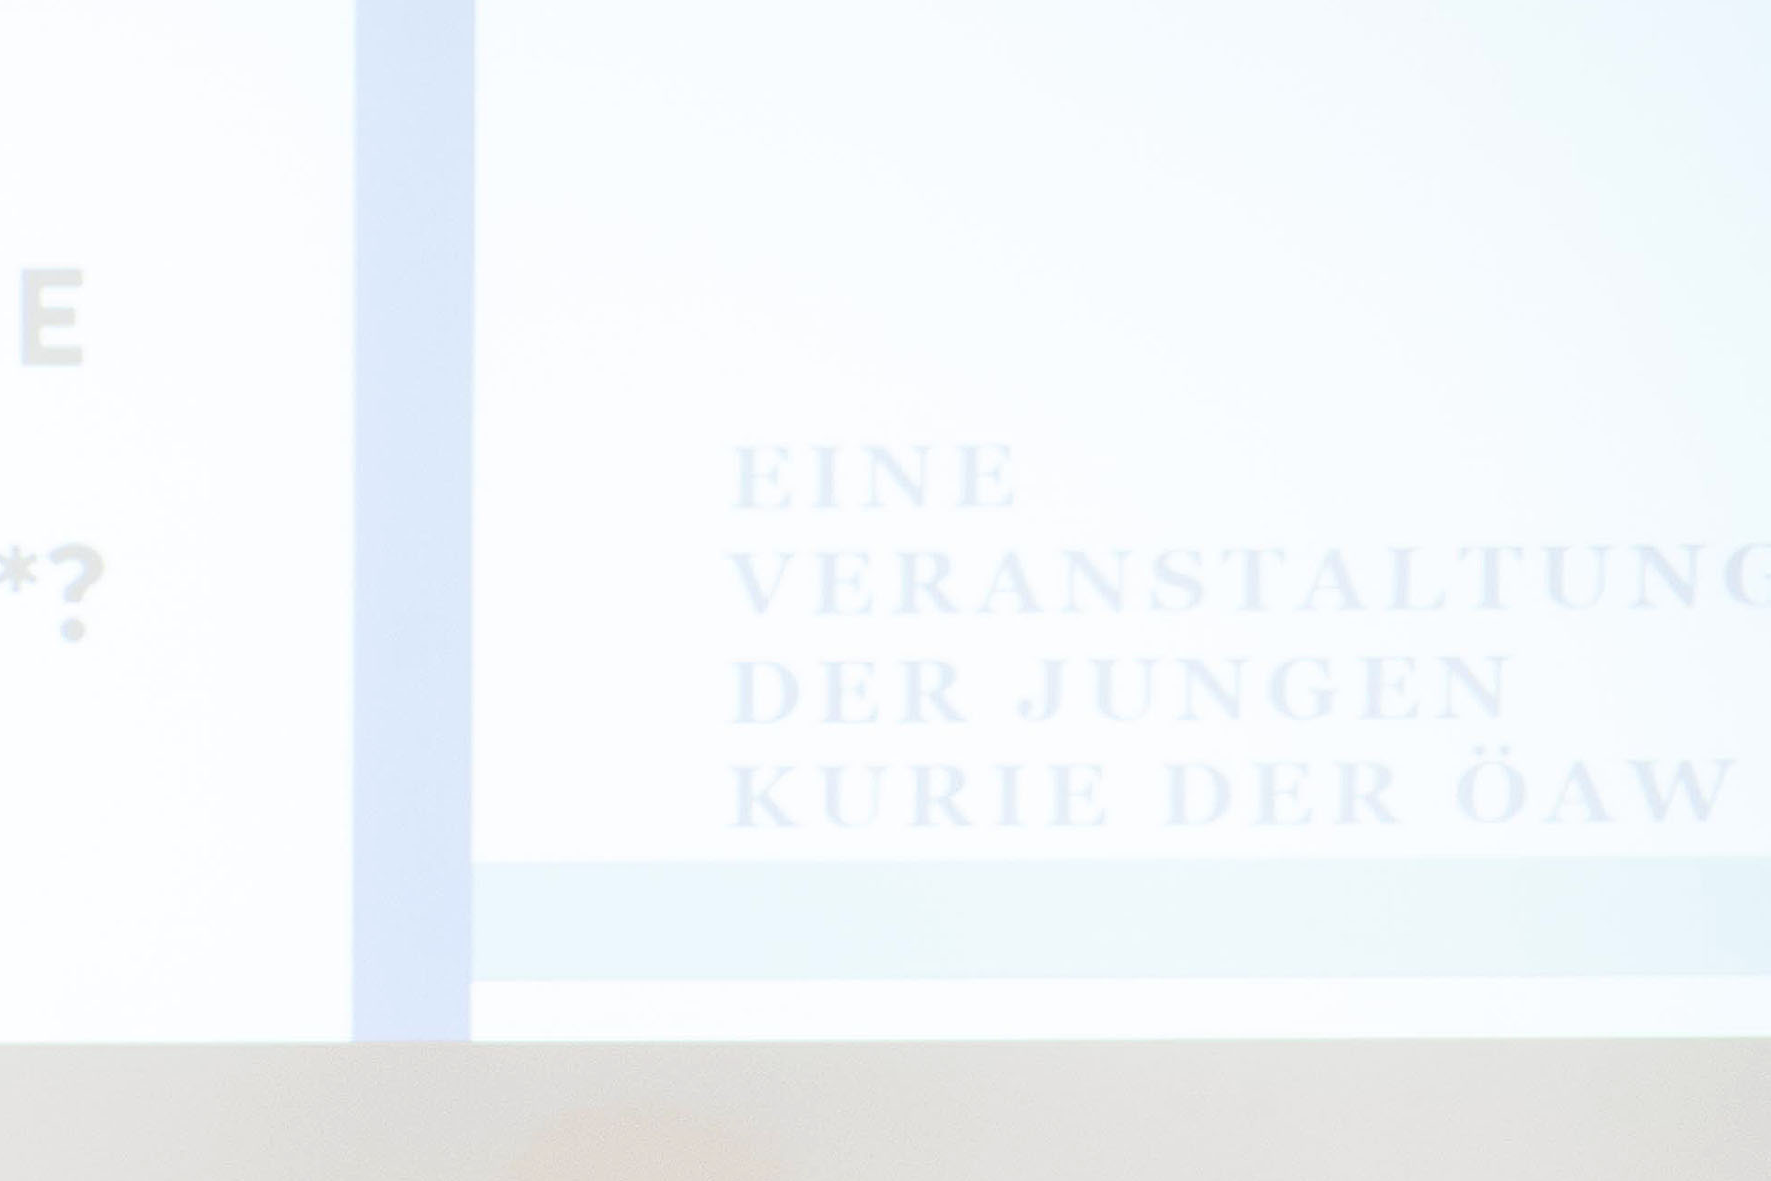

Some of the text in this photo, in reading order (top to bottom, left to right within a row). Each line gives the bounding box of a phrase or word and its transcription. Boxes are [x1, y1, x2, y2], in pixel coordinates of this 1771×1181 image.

[732, 443, 1016, 511] EINE
[727, 543, 1771, 616] VERANSTALTUNG
[732, 652, 1511, 725] DER JUNGEN
[729, 744, 1736, 830] KURIE DER ÖAW
